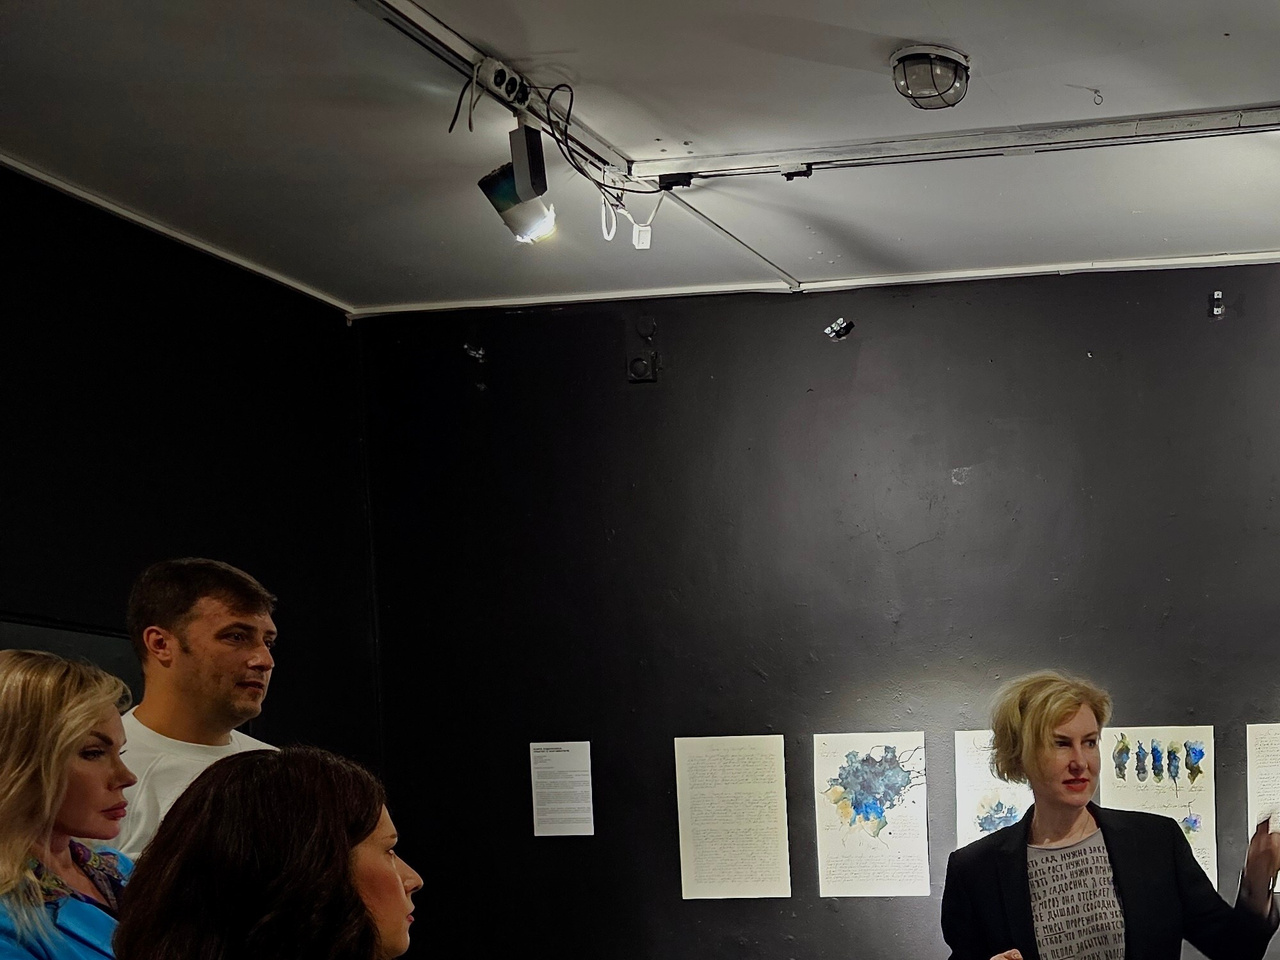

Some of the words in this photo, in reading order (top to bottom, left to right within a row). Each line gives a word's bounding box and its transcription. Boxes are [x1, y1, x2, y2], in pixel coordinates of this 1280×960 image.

[1041, 855, 1057, 864] САД
[1060, 848, 1087, 861] НУЖНО
[1048, 864, 1063, 874] РОСТ
[1066, 858, 1089, 870] НУЖНО
[1051, 872, 1067, 883] БОЛЬ
[1070, 867, 1093, 878] НУЖНО
[1049, 878, 1088, 894] САДОВНИК
[1039, 897, 1059, 911] МОРОЗ
[1062, 895, 1075, 905] ОНА
[1078, 888, 1109, 902] ОТСЕКАЕТ
[1048, 905, 1080, 922] ДЫШАЛО
[1083, 900, 1116, 913] СВОБОДНО
[1042, 922, 1064, 935] МИРЫ
[1064, 932, 1075, 941] ЧТО
[1051, 945, 1073, 960] ПЕПЛА
[1076, 934, 1109, 954] ЗАБЫТЫХ
